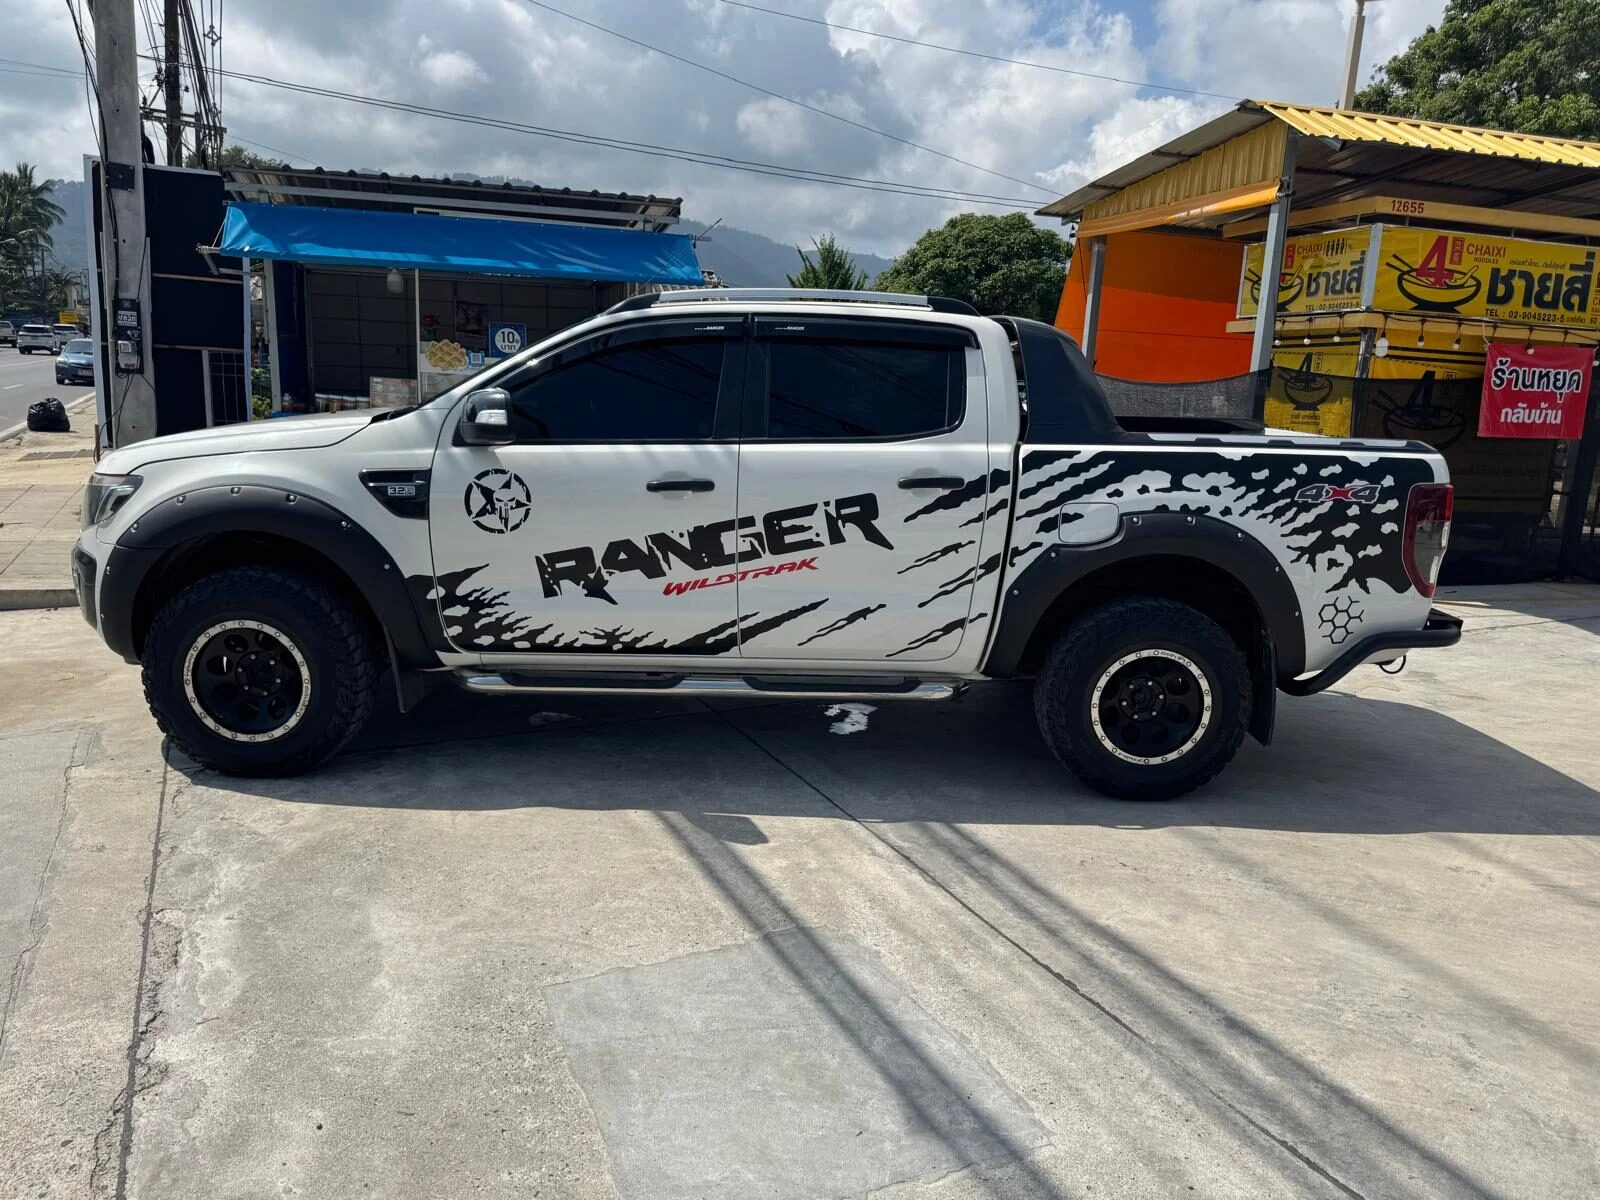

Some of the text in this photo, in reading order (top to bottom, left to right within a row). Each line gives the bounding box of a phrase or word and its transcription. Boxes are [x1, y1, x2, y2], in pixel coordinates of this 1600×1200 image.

[1391, 199, 1425, 214] 12655
[1416, 235, 1454, 288] 4
[1466, 243, 1506, 258] CHAIXI
[1474, 256, 1498, 265] NOODLES
[1486, 251, 1596, 313] ชายสี่
[1485, 308, 1499, 318] TEL
[1508, 310, 1565, 324] 02-9045223-5
[501, 331, 515, 344] 10
[1491, 358, 1583, 403] ร้านหยุด
[1500, 402, 1562, 424] กลับบ้าน
[535, 492, 895, 606] RANGER
[662, 556, 820, 597] WILDTRAK
